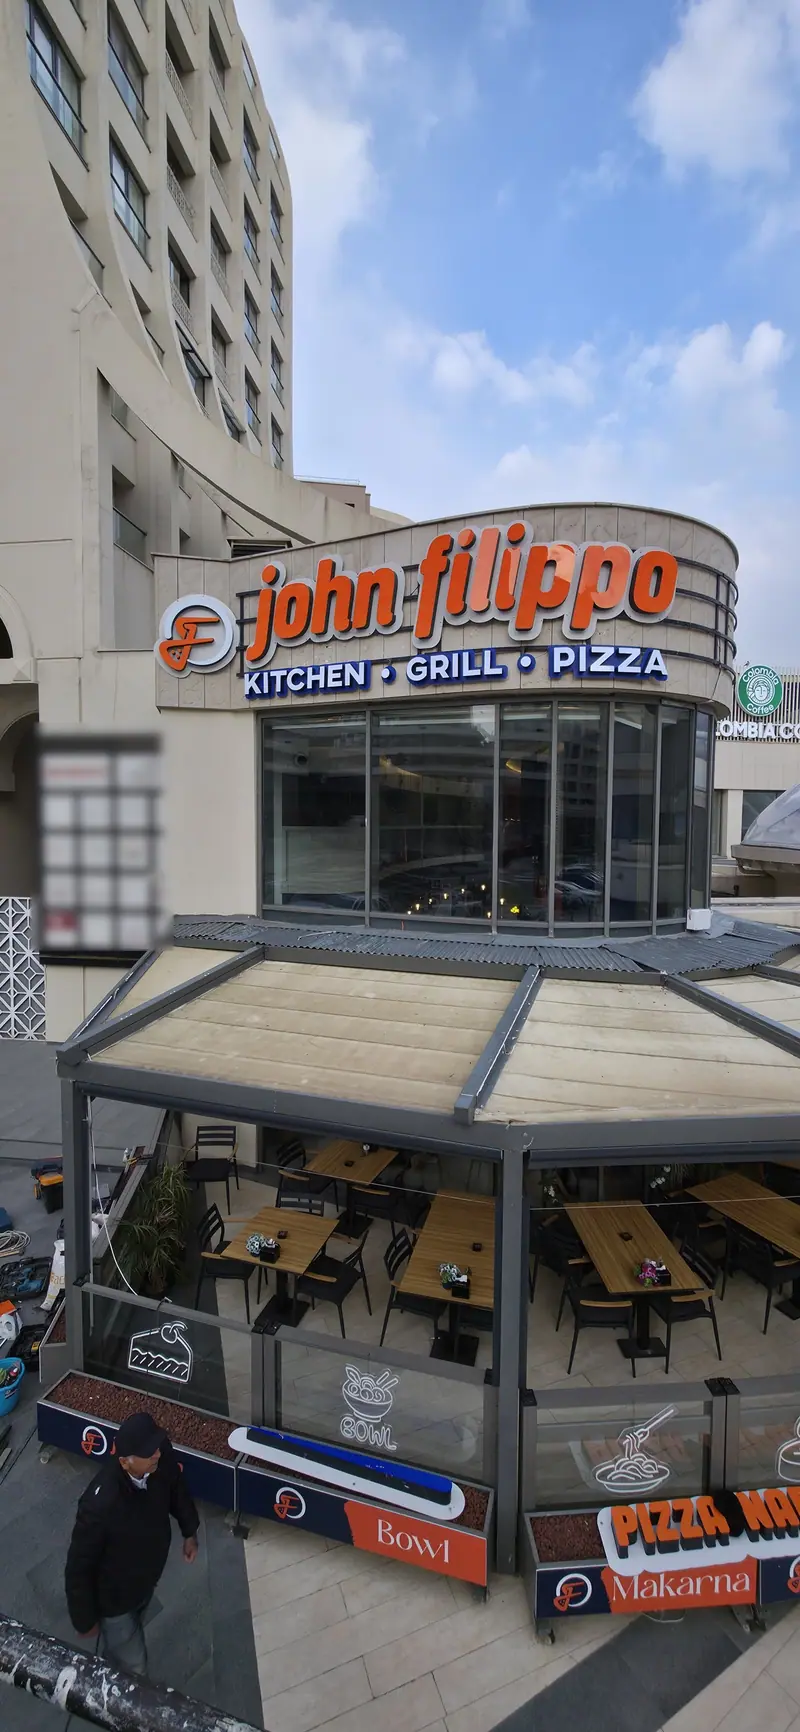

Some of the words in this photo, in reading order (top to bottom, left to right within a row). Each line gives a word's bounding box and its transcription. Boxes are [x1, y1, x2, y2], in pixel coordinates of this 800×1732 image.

[246, 558, 396, 663] john
[414, 522, 679, 639] filippo
[244, 661, 366, 696] KITCHEN
[406, 649, 503, 683] GRILL
[553, 645, 669, 677] PIZZA
[742, 667, 780, 686] Colombia
[746, 703, 775, 715] Coffee
[340, 1415, 398, 1451] BOWL
[377, 1518, 450, 1564] Bowl
[610, 1495, 731, 1552] PIZZA
[612, 1571, 750, 1601] Makarna
